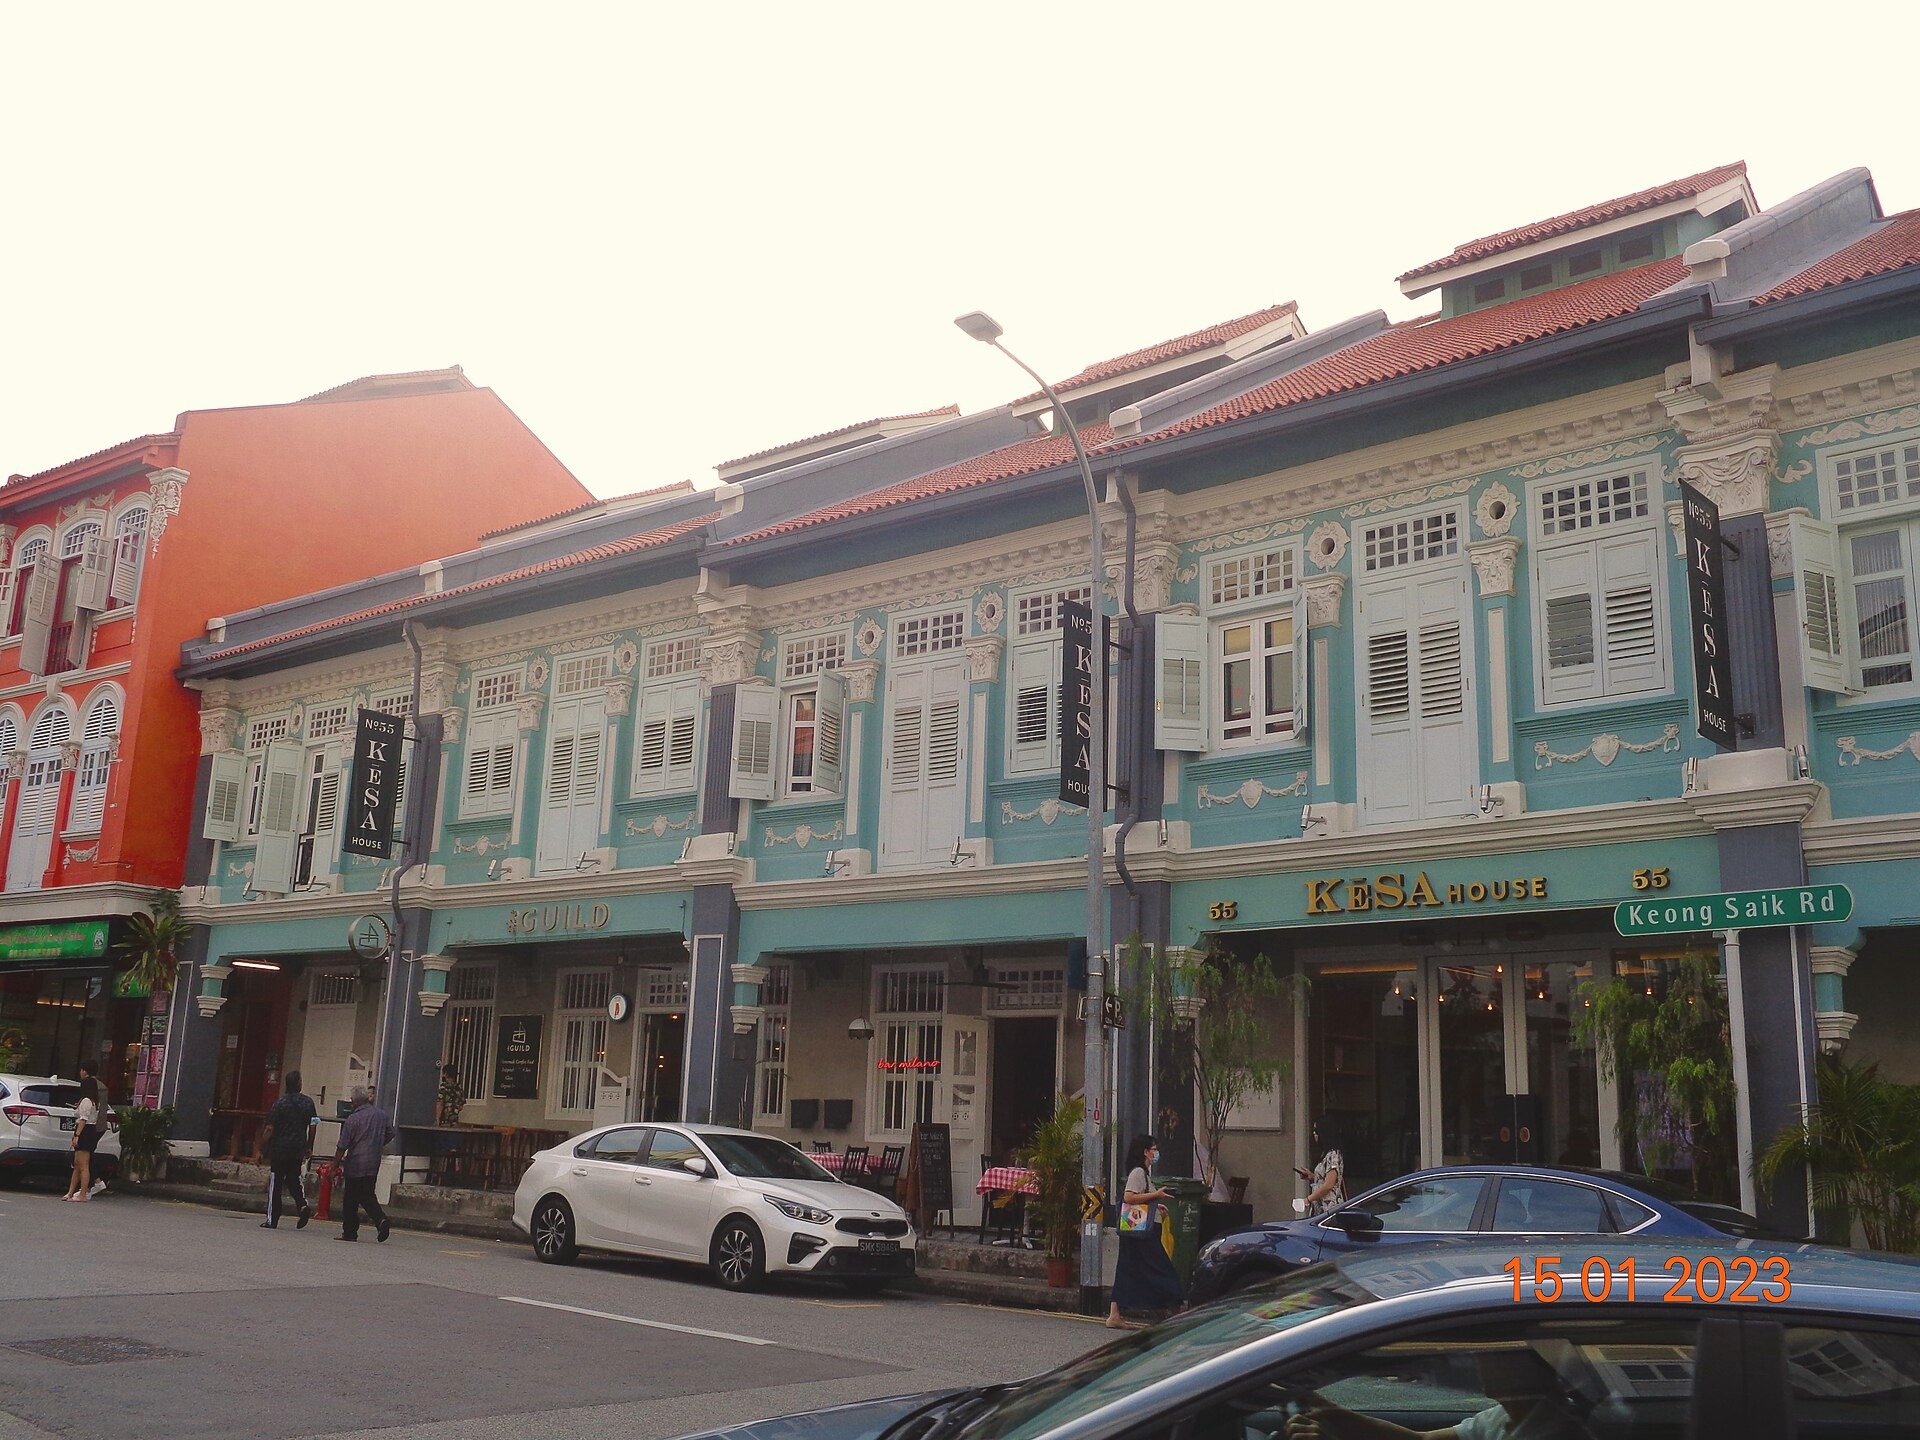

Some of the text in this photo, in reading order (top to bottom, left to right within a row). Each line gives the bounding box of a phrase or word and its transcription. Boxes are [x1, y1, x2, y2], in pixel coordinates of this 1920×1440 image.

[1703, 709, 1727, 732] HOUSE
[1067, 779, 1090, 796] HOU
[351, 836, 382, 850] HOUSE
[1448, 877, 1548, 902] HOUSE
[1632, 867, 1670, 890] 55
[521, 903, 610, 932] GUILD
[1208, 901, 1238, 920] 55
[1629, 889, 1835, 926] Keong Saik Rd
[877, 1056, 941, 1069] bar milano
